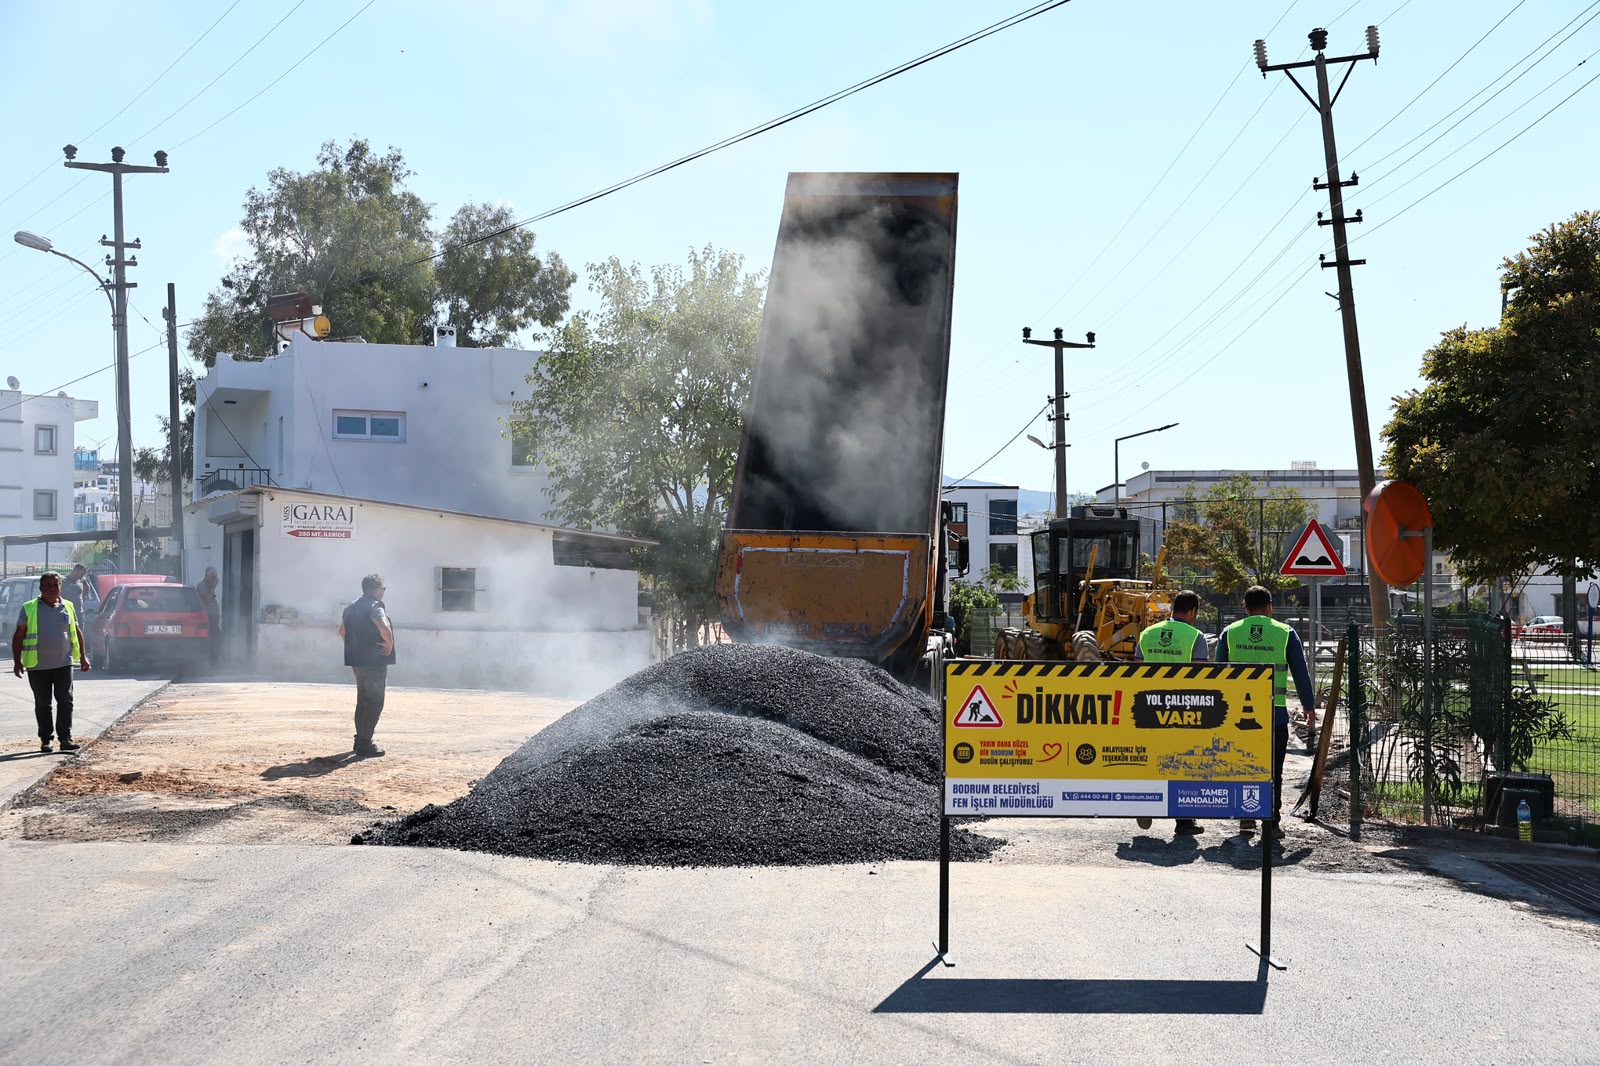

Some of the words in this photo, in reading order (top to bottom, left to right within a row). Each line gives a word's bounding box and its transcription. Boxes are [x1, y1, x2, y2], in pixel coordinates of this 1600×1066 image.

[293, 504, 354, 525] GARAJ
[1016, 686, 1123, 726] DİKKAT!
[1146, 694, 1163, 706] YOL
[1164, 694, 1215, 710] ÇALIŞMASI
[1156, 710, 1203, 726] VAR!
[980, 740, 995, 748] YARIN
[997, 740, 1011, 748] DAHA
[1012, 739, 1029, 748] GÜZEL
[980, 748, 989, 757] BİR
[990, 749, 1014, 757] BODRUM
[1015, 748, 1026, 758] İÇİN
[1102, 745, 1134, 755] ANLAYIŞINIZ
[1135, 744, 1147, 756] İÇİN
[980, 757, 998, 765] BUGÜN
[999, 757, 1034, 767] ÇALIŞIYORUZ
[1102, 754, 1128, 763] TEŞEKKÜR
[1130, 754, 1149, 762] EDERİZ
[952, 783, 990, 795] BODRUM
[992, 782, 1040, 796] BELEDİYESİ
[952, 797, 968, 808] FEN
[970, 795, 998, 811] İŞLERİ
[999, 795, 1054, 809] MÜDÜRLÜĞÜ
[1123, 793, 1160, 801] bodrum.bel.tr
[1178, 796, 1229, 804] MANDALİNCİ
